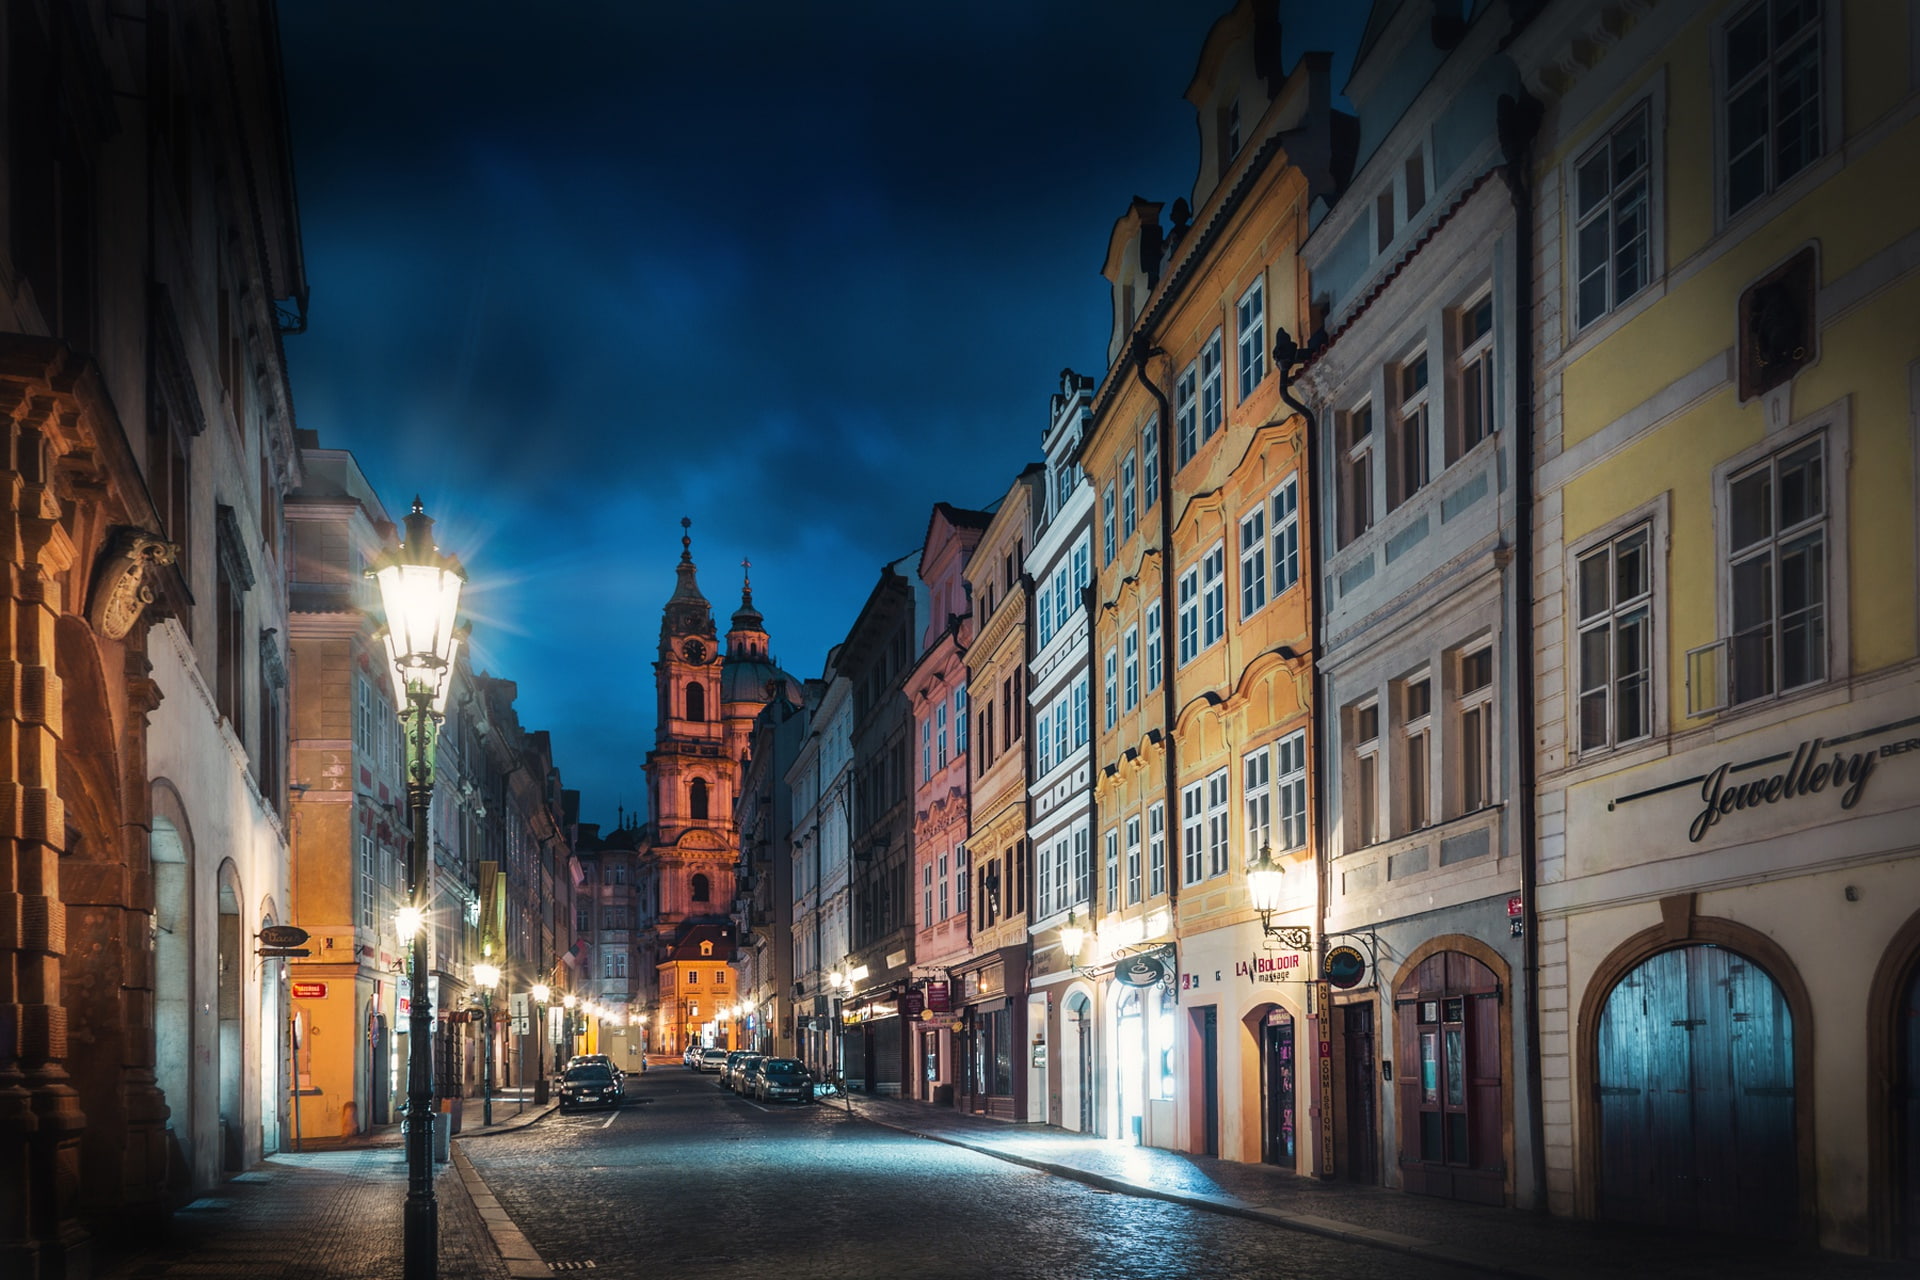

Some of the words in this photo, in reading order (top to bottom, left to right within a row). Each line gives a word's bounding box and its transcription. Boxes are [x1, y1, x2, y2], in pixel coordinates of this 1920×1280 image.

[1689, 738, 1877, 842] Jewellery
[1880, 738, 1920, 758] BER
[1236, 961, 1248, 976] LA
[1259, 971, 1289, 982] massage
[1320, 985, 1327, 999] NO
[1322, 1060, 1330, 1131] COMMISSION
